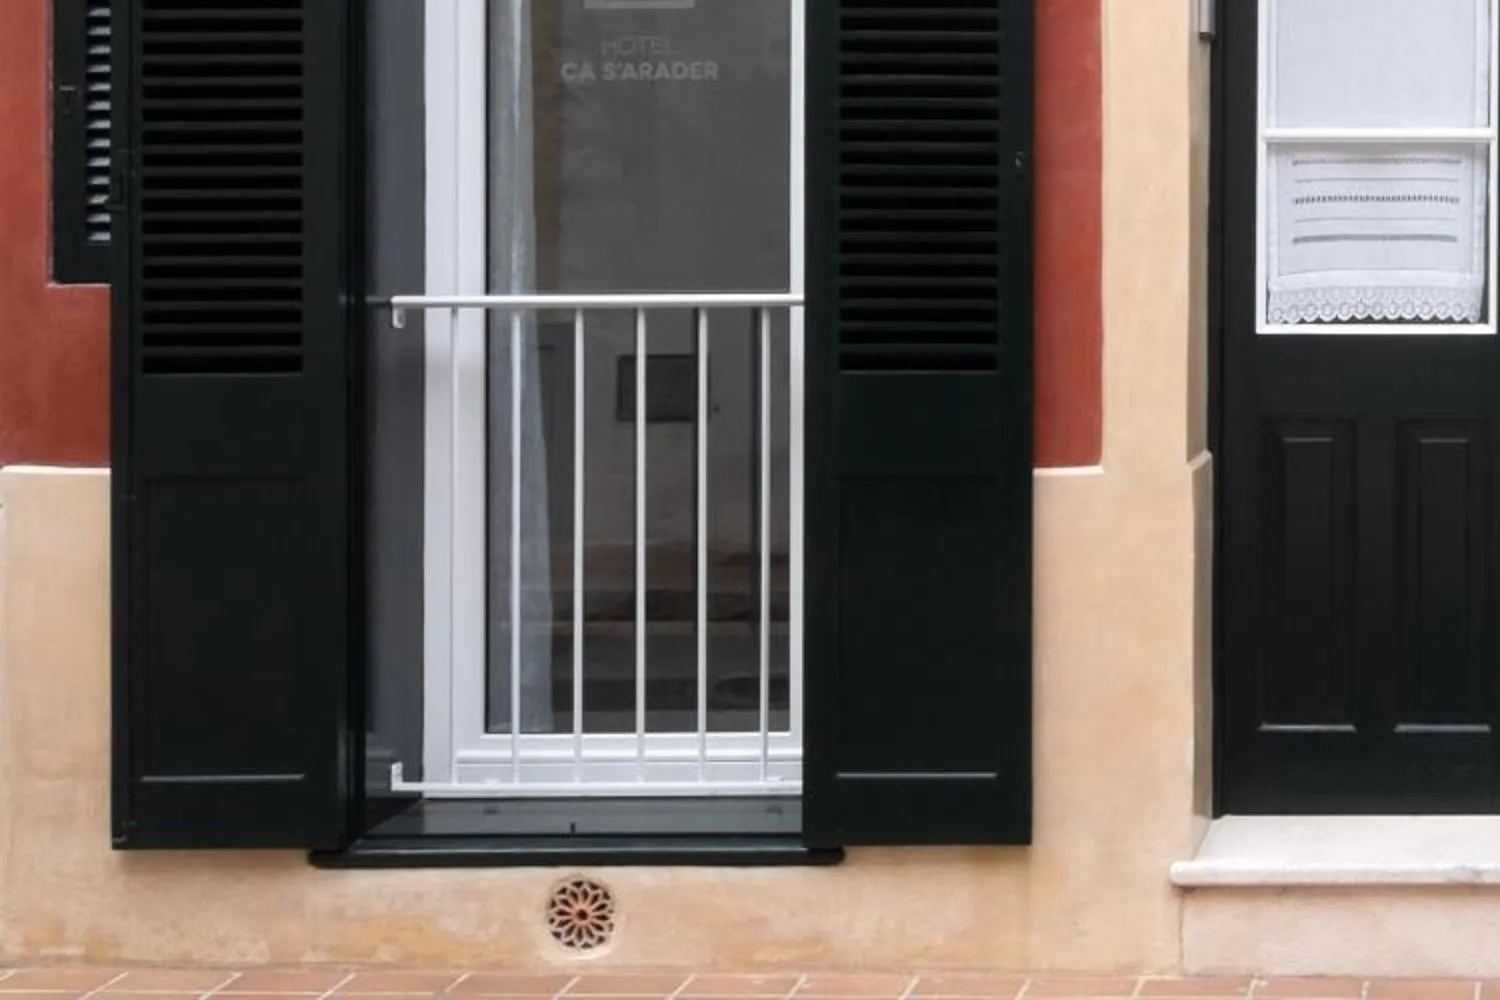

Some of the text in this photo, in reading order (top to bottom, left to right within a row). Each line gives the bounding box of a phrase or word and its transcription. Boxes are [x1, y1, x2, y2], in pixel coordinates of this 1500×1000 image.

[600, 35, 677, 55] HOTEL
[560, 60, 720, 81] CA S'ARADER
